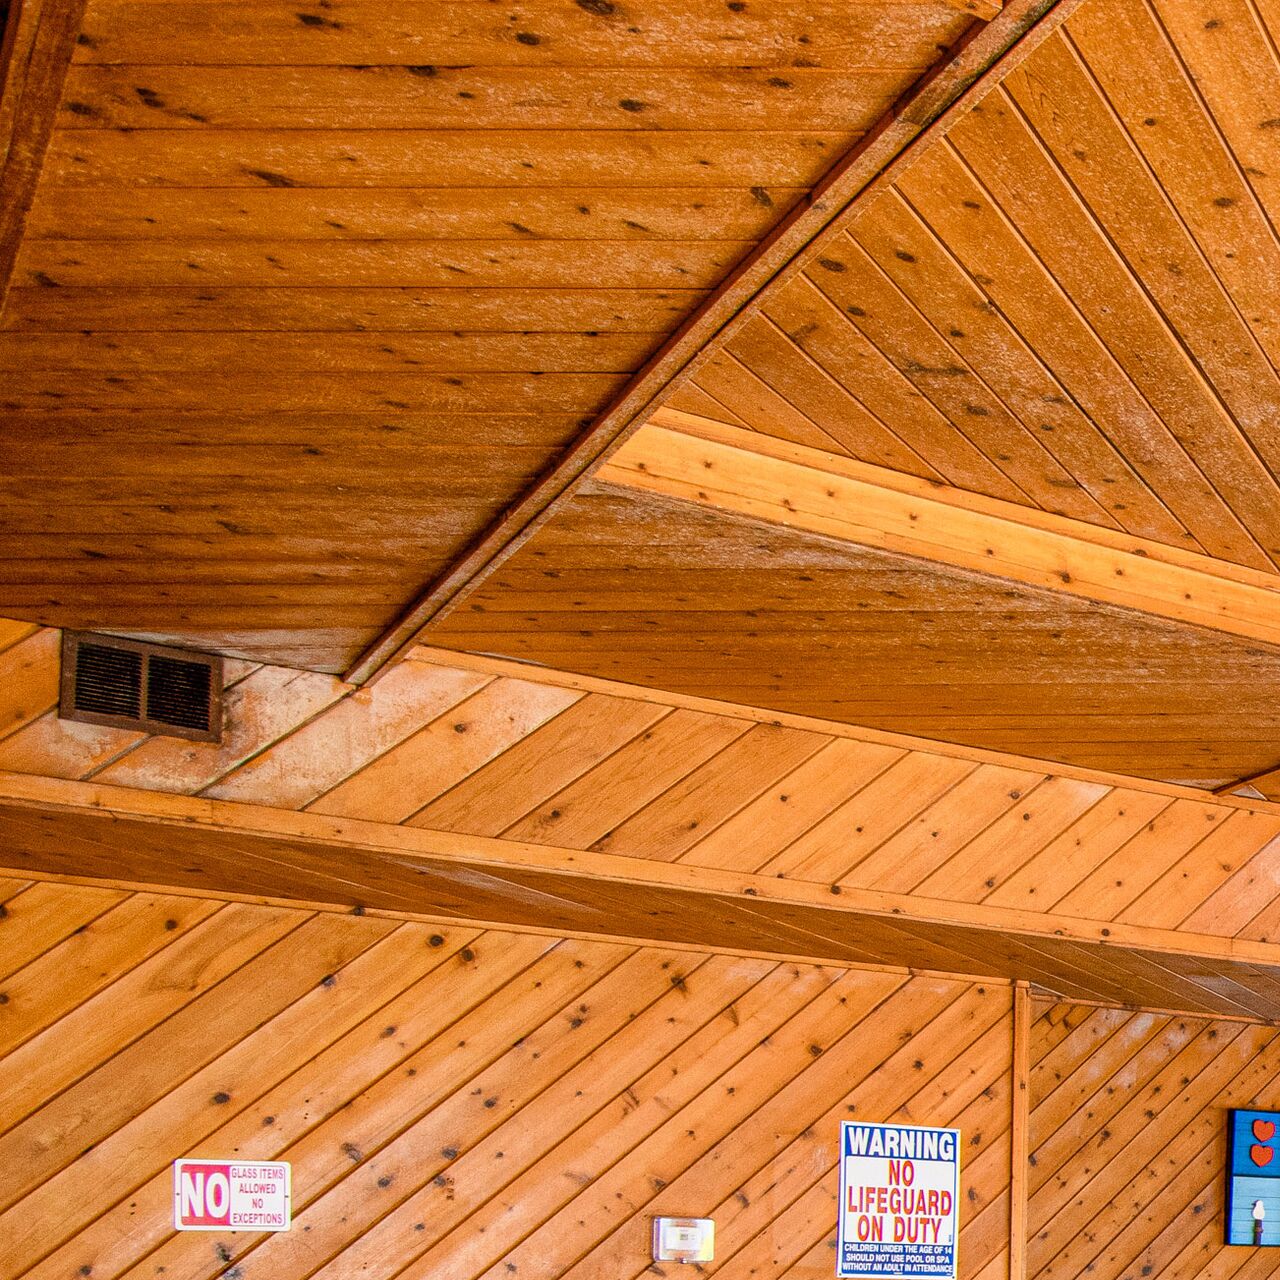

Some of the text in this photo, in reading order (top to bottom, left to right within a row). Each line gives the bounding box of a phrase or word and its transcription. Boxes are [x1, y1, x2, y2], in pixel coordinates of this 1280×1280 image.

[848, 1127, 954, 1161] WARNING
[232, 1168, 284, 1180] GLASS ITEMS
[889, 1160, 914, 1187] NO
[239, 1183, 276, 1194] ALLOWED
[181, 1172, 229, 1218] NO
[252, 1199, 264, 1209] NO
[848, 1186, 952, 1216] LIFEGUARD
[233, 1213, 283, 1224] EXCEPTIONS
[857, 1215, 942, 1244] ON DUTY
[845, 1243, 879, 1252] CHILDREN
[880, 1245, 903, 1253] UNDER
[904, 1245, 918, 1253] THE
[919, 1246, 933, 1254] AGE
[934, 1246, 944, 1254] OF
[846, 1253, 874, 1262] SHOULD
[876, 1254, 890, 1262] NOT
[891, 1254, 904, 1262] USE
[906, 1255, 924, 1263] POOL
[937, 1256, 950, 1264] SPA
[842, 1262, 871, 1271] WITHOUT
[873, 1263, 882, 1271] AN
[883, 1264, 903, 1272] ADULT
[905, 1264, 911, 1272] IN
[912, 1264, 953, 1273] ATTENDANCE
